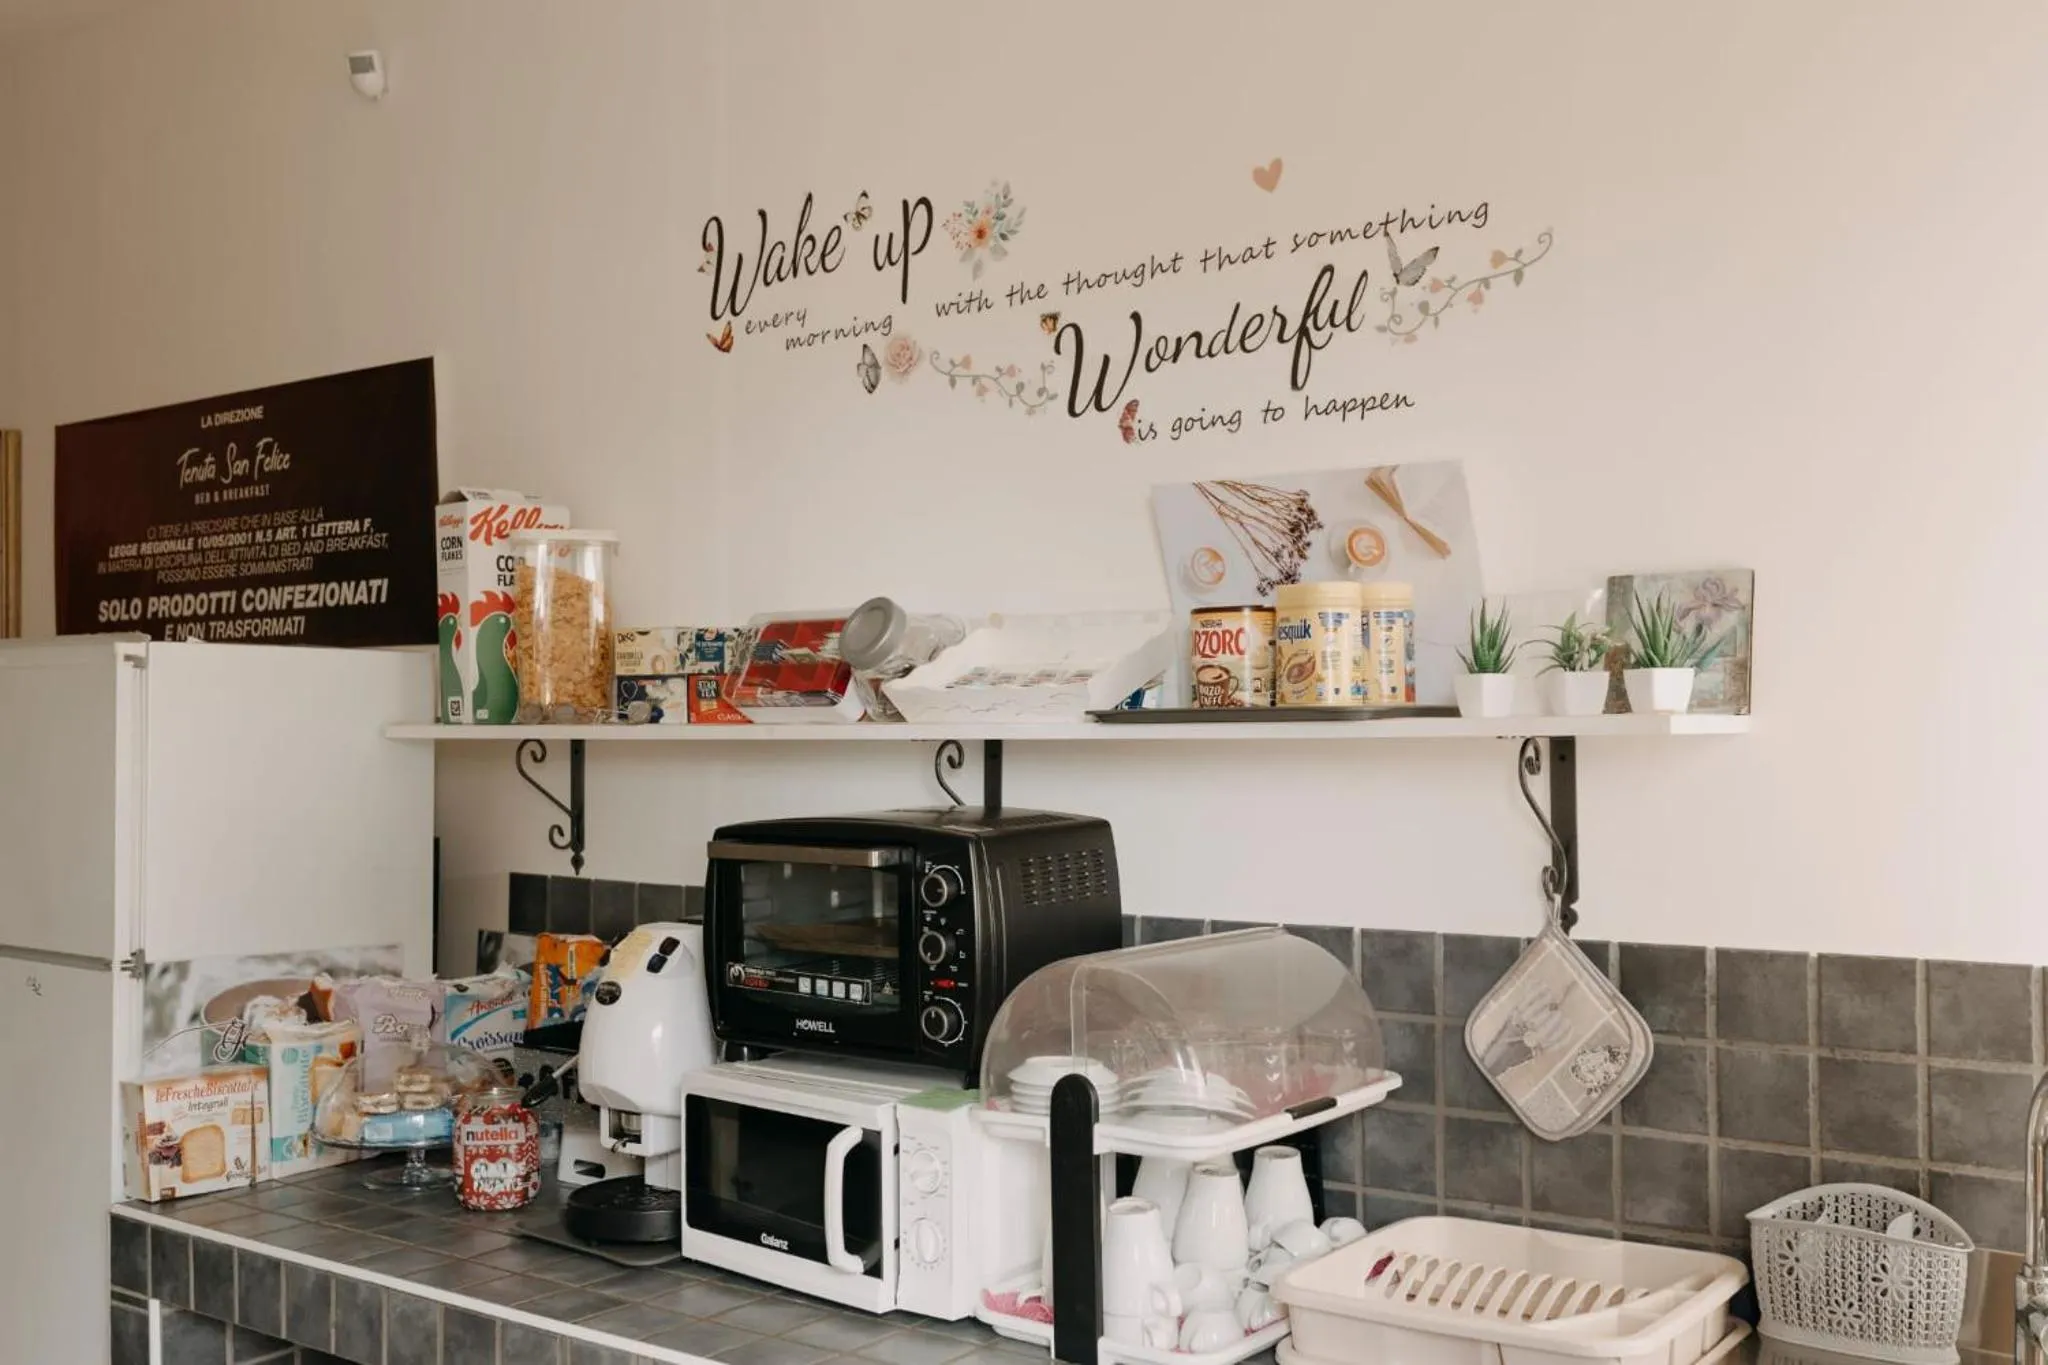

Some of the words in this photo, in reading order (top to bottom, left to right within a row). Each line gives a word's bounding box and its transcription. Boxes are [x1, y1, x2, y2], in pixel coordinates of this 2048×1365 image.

[701, 191, 845, 322] Wake
[872, 196, 934, 304] up
[935, 291, 994, 319] with
[1005, 284, 1049, 308] the
[1062, 254, 1186, 295] thought
[1200, 237, 1277, 273] that
[1291, 200, 1491, 254] something
[744, 306, 808, 335] every
[785, 314, 894, 352] morning
[1053, 263, 1369, 419] Wonderful
[200, 416, 213, 429] LA
[214, 405, 264, 426] DIREZIONE
[1136, 419, 1157, 442] is
[1170, 408, 1243, 442] going
[1260, 399, 1286, 425] to
[1303, 391, 1415, 423] happen
[176, 447, 216, 490] Tenuta
[220, 442, 249, 484] San
[254, 437, 290, 481] Felice
[273, 510, 299, 526] BASE
[300, 506, 324, 523] ALLA
[108, 543, 139, 560] LEGGE
[140, 538, 195, 555] REGIONALE
[310, 519, 361, 538] LETTERA
[281, 540, 301, 557] BED
[302, 538, 325, 555] AND
[440, 535, 464, 552] CORN
[441, 551, 464, 562] FLAKES
[157, 568, 200, 584] POSSONO
[201, 563, 238, 581] ESSERE
[98, 598, 143, 623] SOLO
[146, 589, 237, 620] PRODOTTI
[241, 578, 389, 612] CONFEZIONATI
[164, 624, 174, 642] E
[176, 621, 205, 640] NON
[208, 615, 306, 640] TRASFORMATI
[701, 689, 719, 698] TEA
[795, 1018, 836, 1034] HOWELL
[466, 1127, 519, 1142] nutella
[760, 1232, 789, 1251] Galanz
